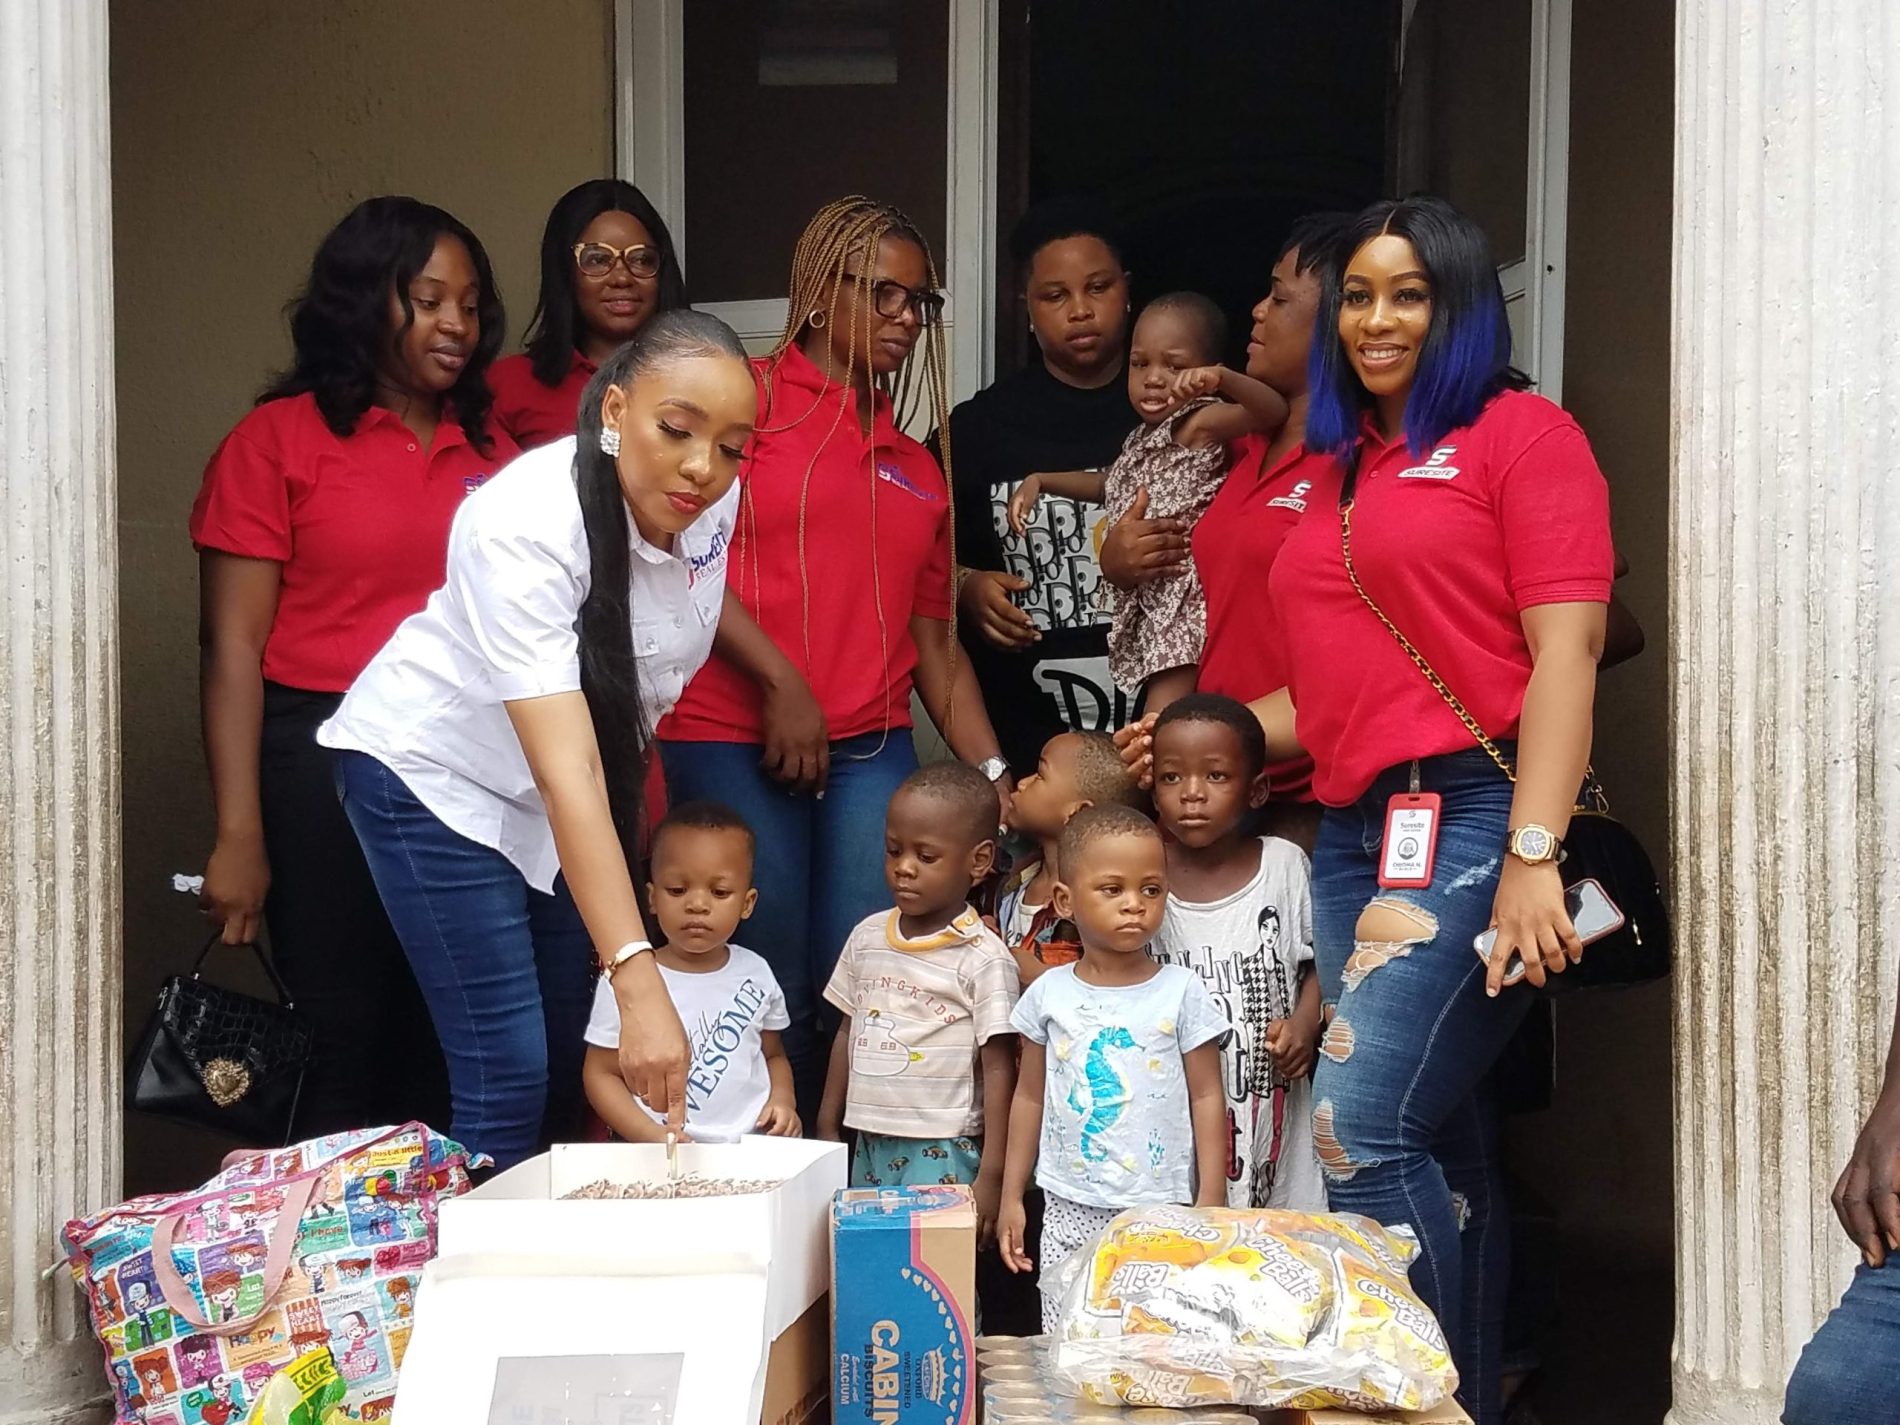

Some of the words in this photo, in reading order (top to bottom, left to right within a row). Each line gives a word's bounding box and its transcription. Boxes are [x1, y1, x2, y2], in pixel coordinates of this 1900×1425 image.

[840, 1353, 850, 1405] CALCIUM
[863, 1344, 874, 1418] BISCUITS
[903, 1350, 912, 1409] SWEETENED
[914, 1358, 923, 1399] OXFORD
